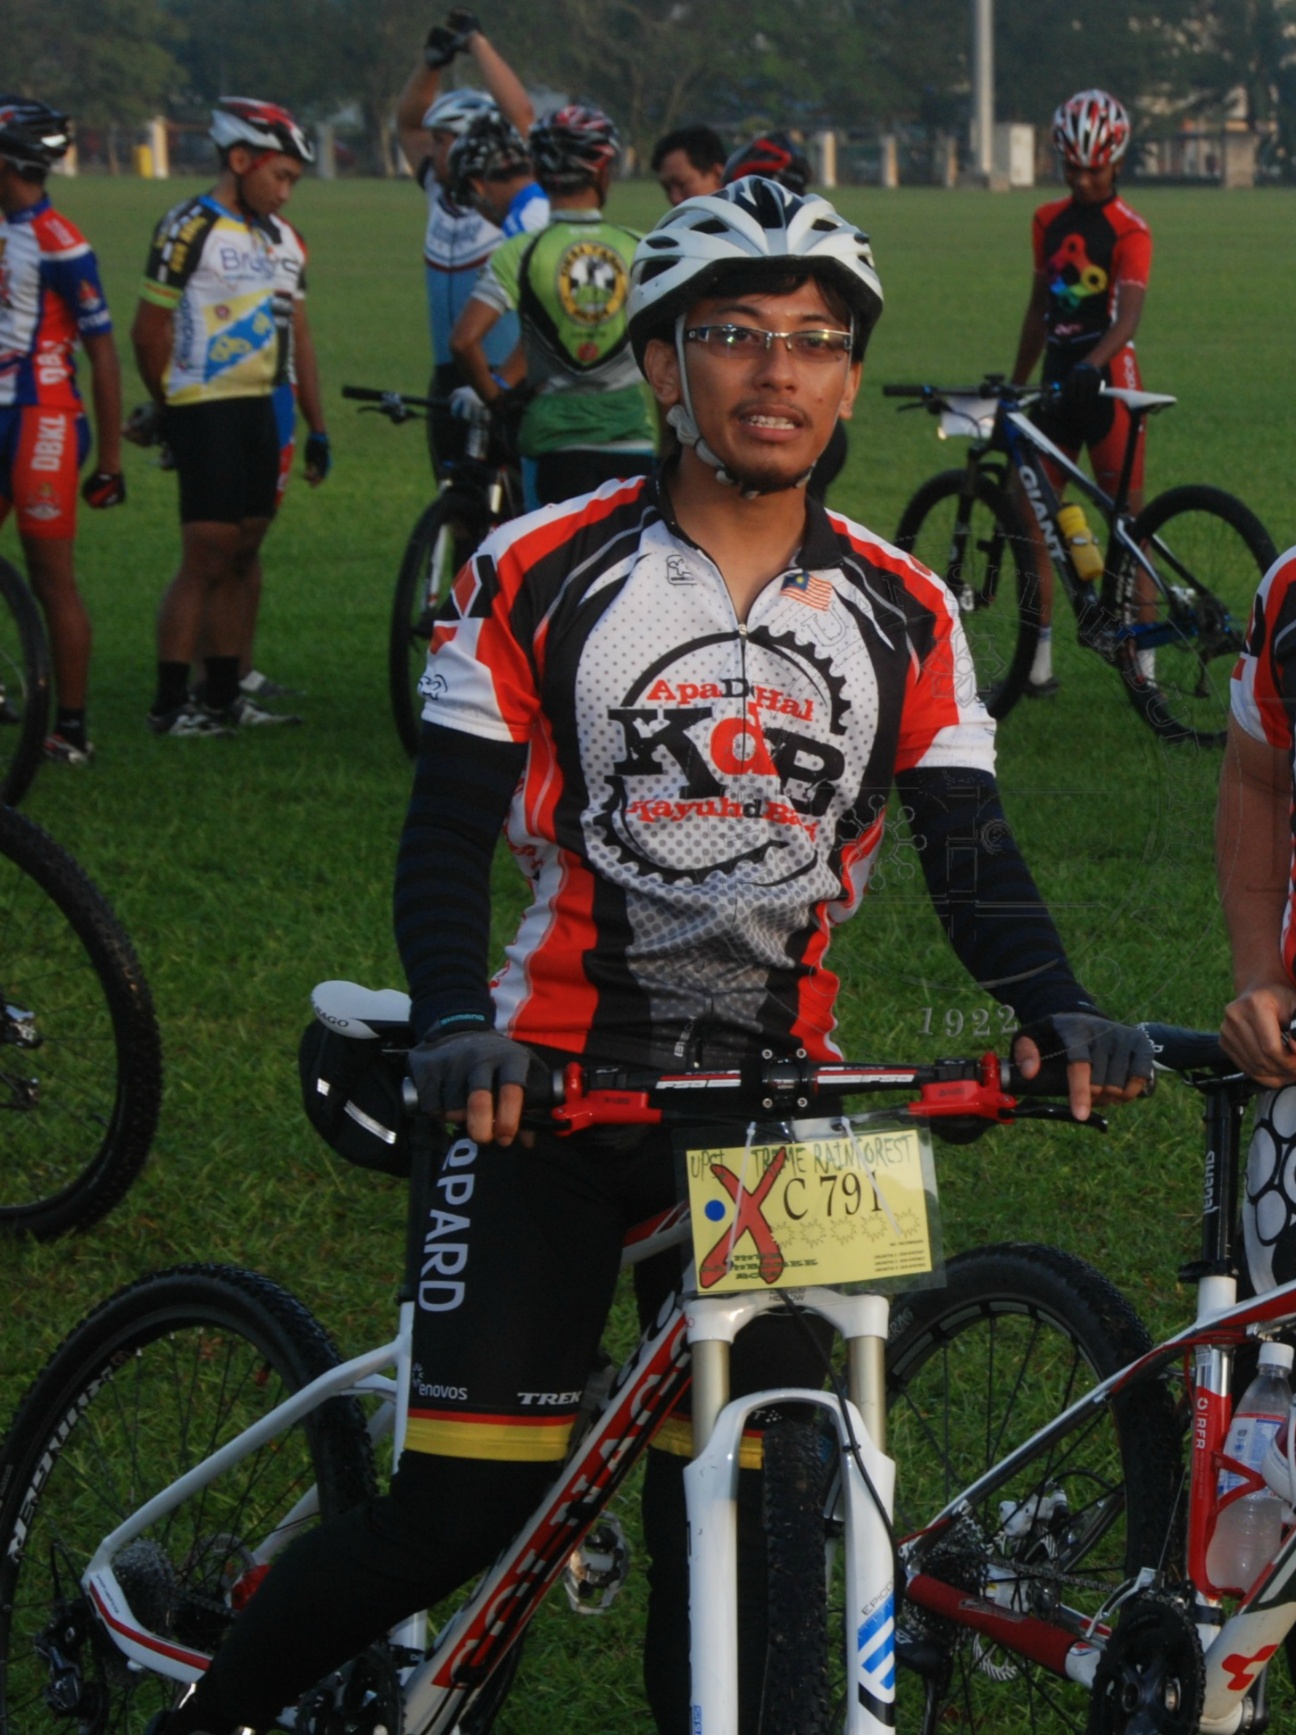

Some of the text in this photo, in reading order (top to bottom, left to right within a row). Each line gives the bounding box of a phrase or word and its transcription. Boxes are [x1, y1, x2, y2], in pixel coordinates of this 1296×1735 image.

[31, 415, 67, 472] DBKL
[1019, 464, 1066, 562] GIANT
[647, 678, 814, 721] ApaDHal
[608, 700, 845, 817] KdB
[440, 1013, 485, 1026] SHIMANO
[820, 1170, 883, 1217] 791
[418, 1136, 479, 1313] OPARD
[418, 1383, 468, 1401] enovos
[517, 1391, 582, 1406] TREK
[1197, 1419, 1207, 1449] RFR
